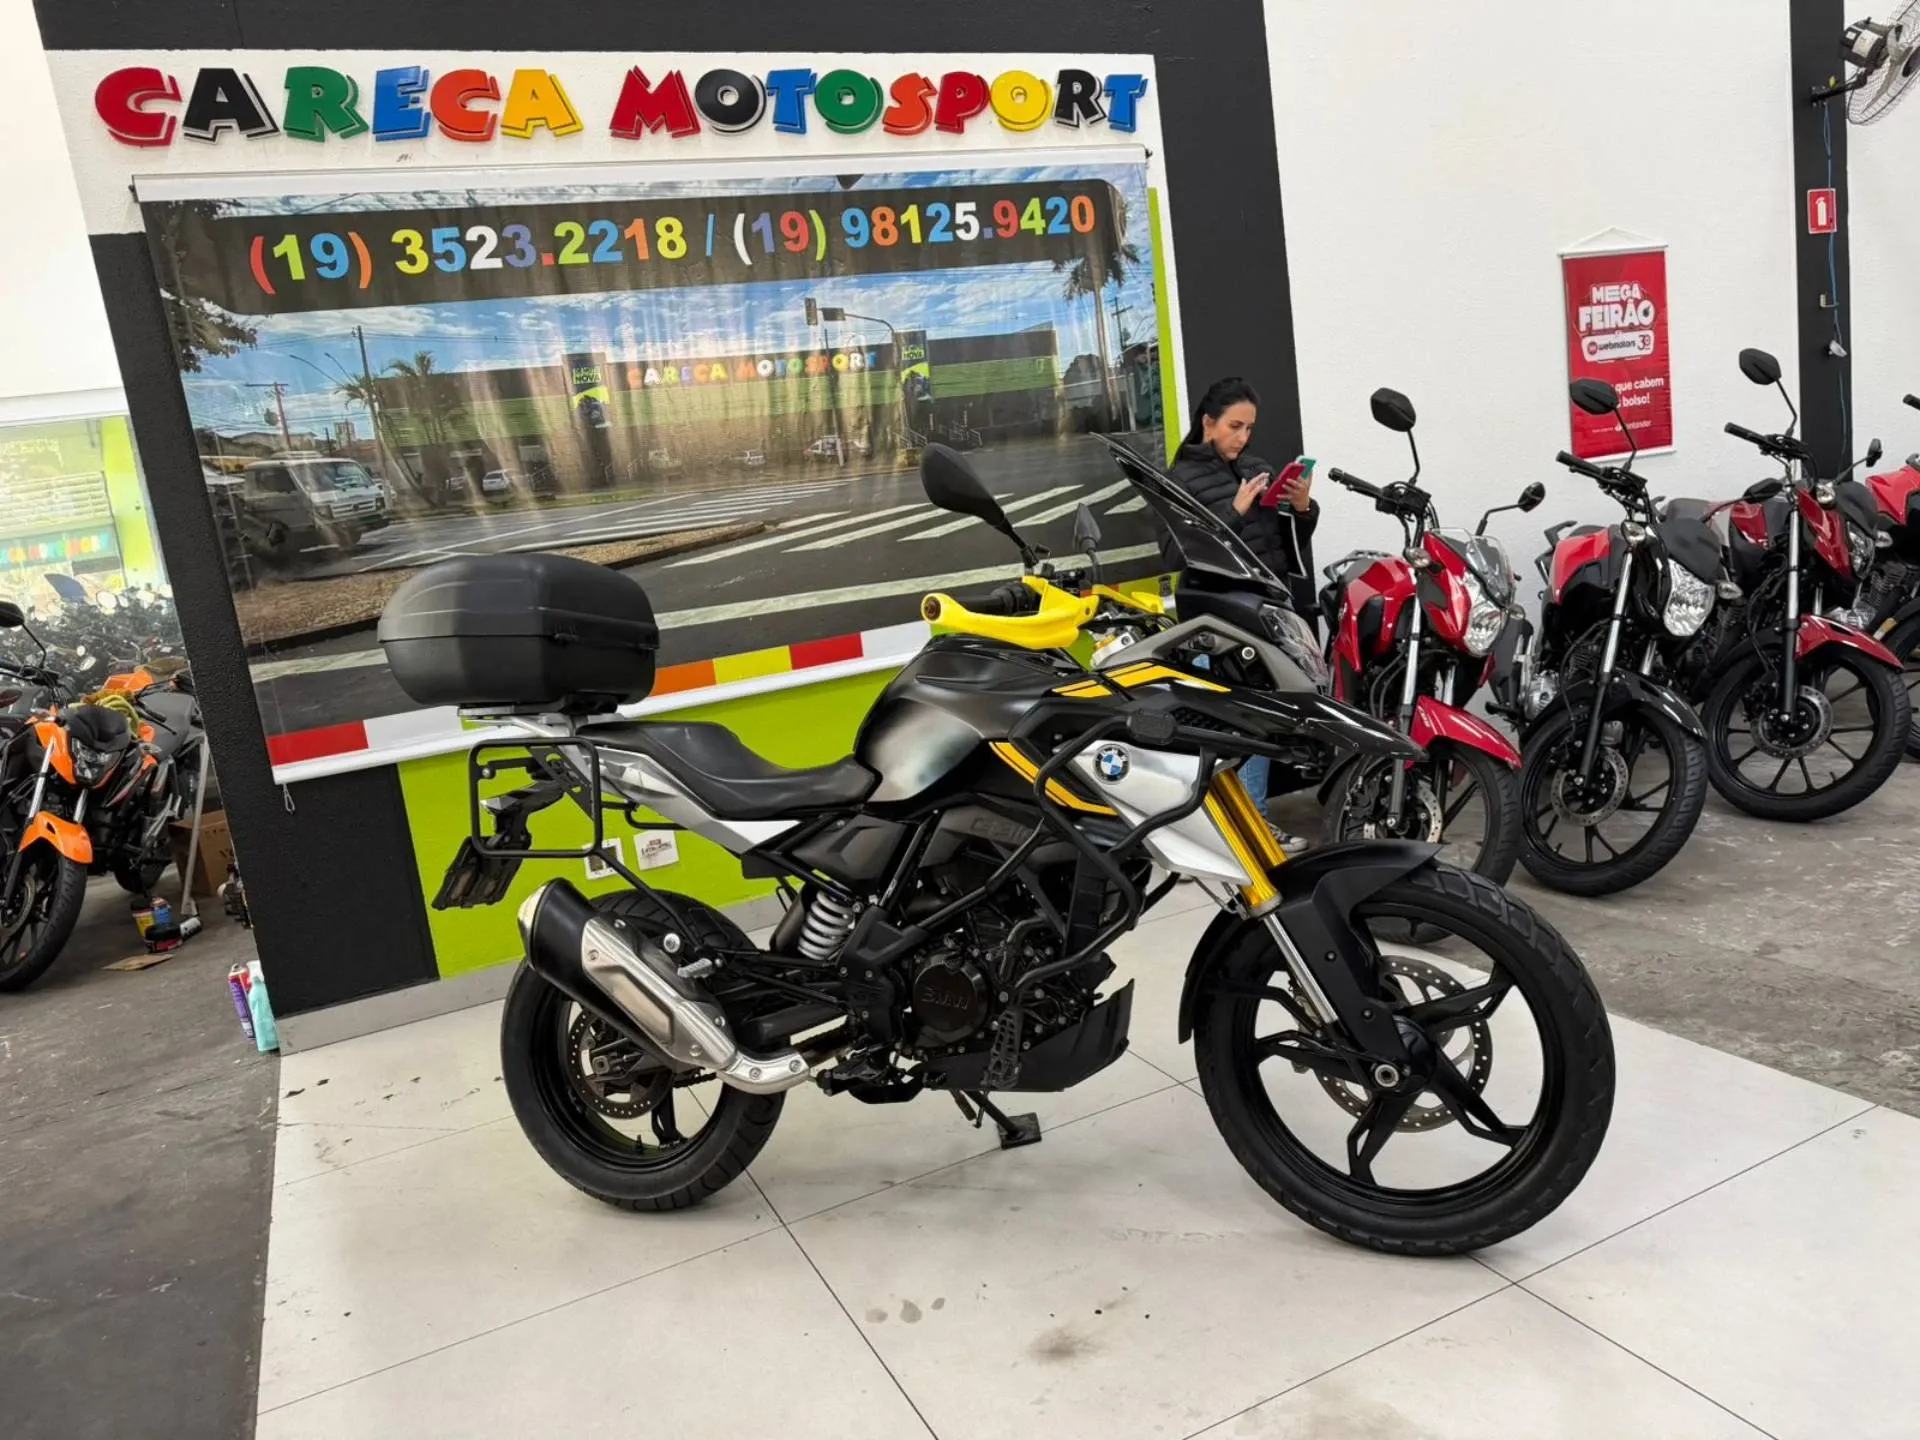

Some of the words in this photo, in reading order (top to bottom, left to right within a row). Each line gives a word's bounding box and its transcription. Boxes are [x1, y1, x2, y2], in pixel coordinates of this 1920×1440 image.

[94, 65, 585, 147] CARECA
[609, 64, 1149, 141] MOTOSPORT
[249, 230, 373, 295] (19)
[390, 216, 687, 275] 3523.2218
[704, 213, 714, 257] /
[733, 209, 827, 266] (19)
[841, 194, 1095, 249] 98125.9420
[1591, 283, 1641, 304] MEGA
[1578, 298, 1656, 333] FEIRÃO
[626, 363, 729, 389] CARECA
[735, 351, 878, 381] MOTOSPORT
[1615, 381, 1633, 394] que
[1634, 376, 1664, 389] cabem
[1623, 392, 1651, 407] bolso!
